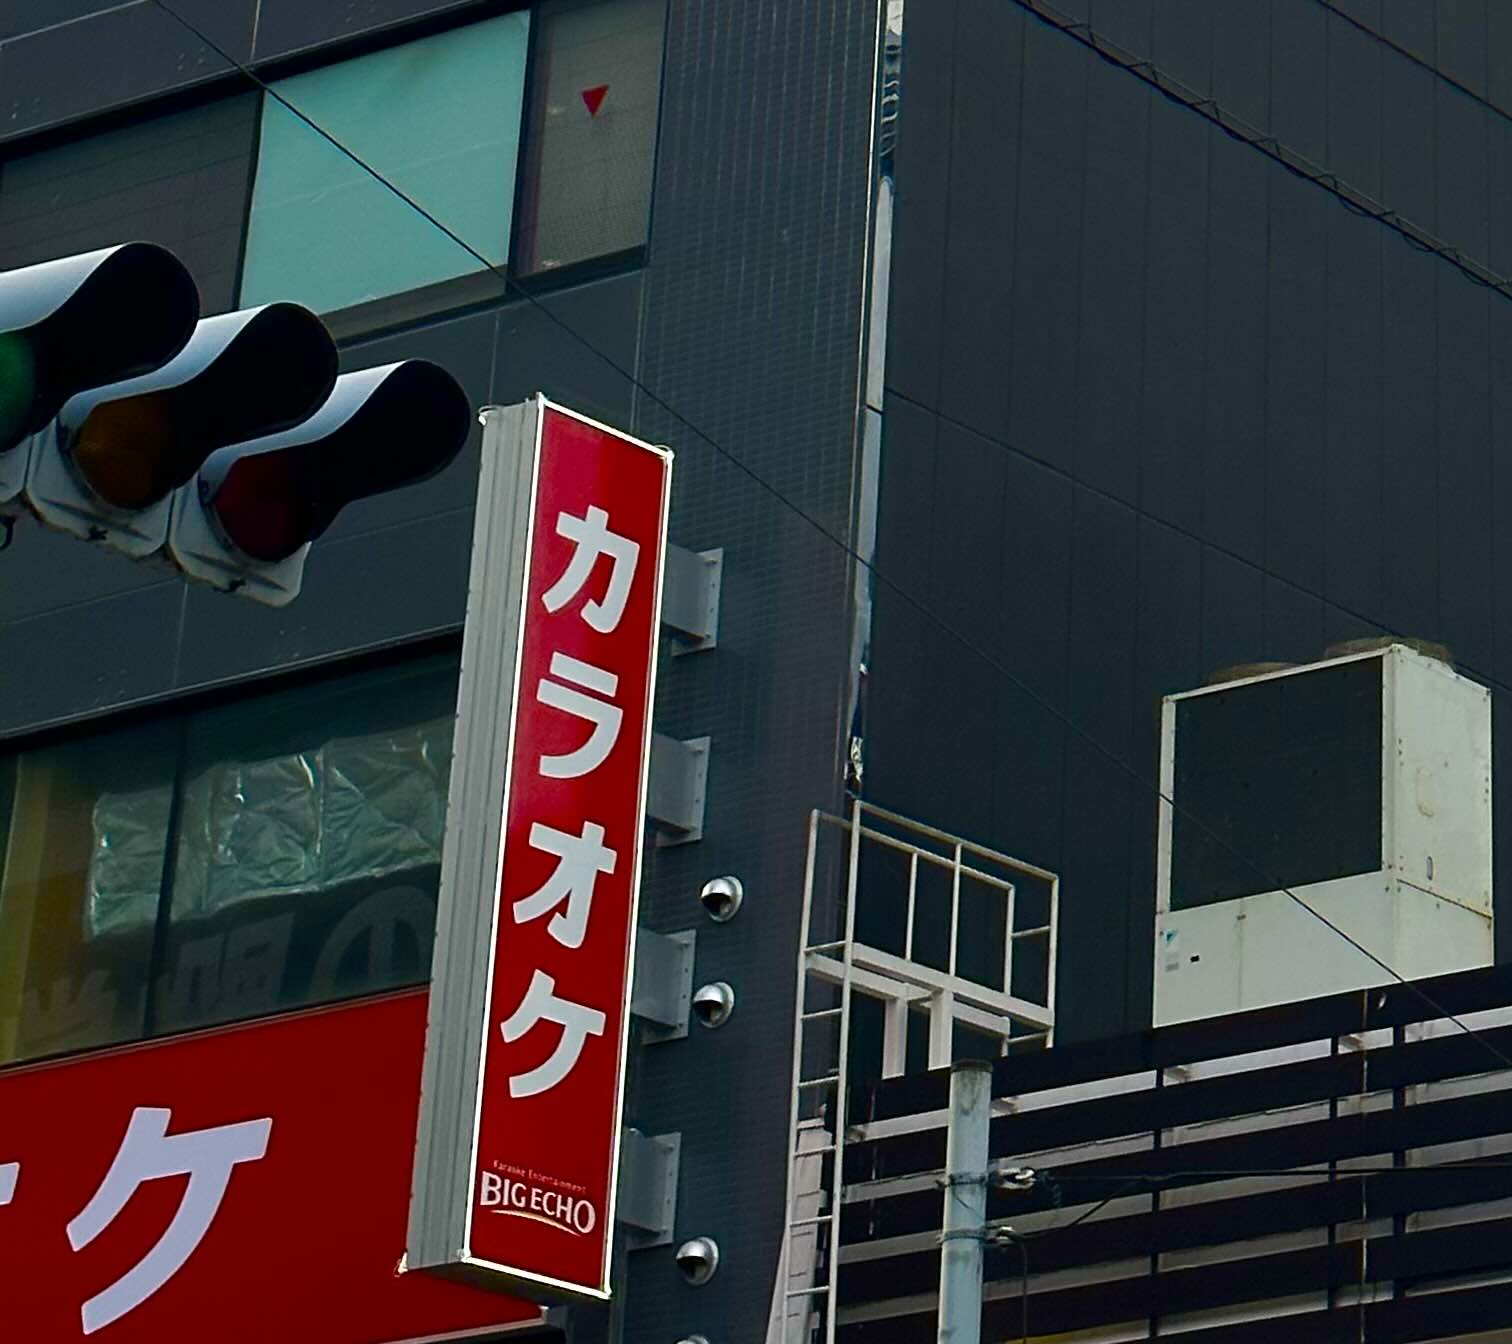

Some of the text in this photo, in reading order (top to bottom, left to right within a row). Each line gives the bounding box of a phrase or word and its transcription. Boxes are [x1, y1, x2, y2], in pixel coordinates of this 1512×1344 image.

[499, 503, 642, 1099] カラオケ
[0, 1106, 273, 1336] ケ
[480, 1170, 597, 1234] BIG ECHO
